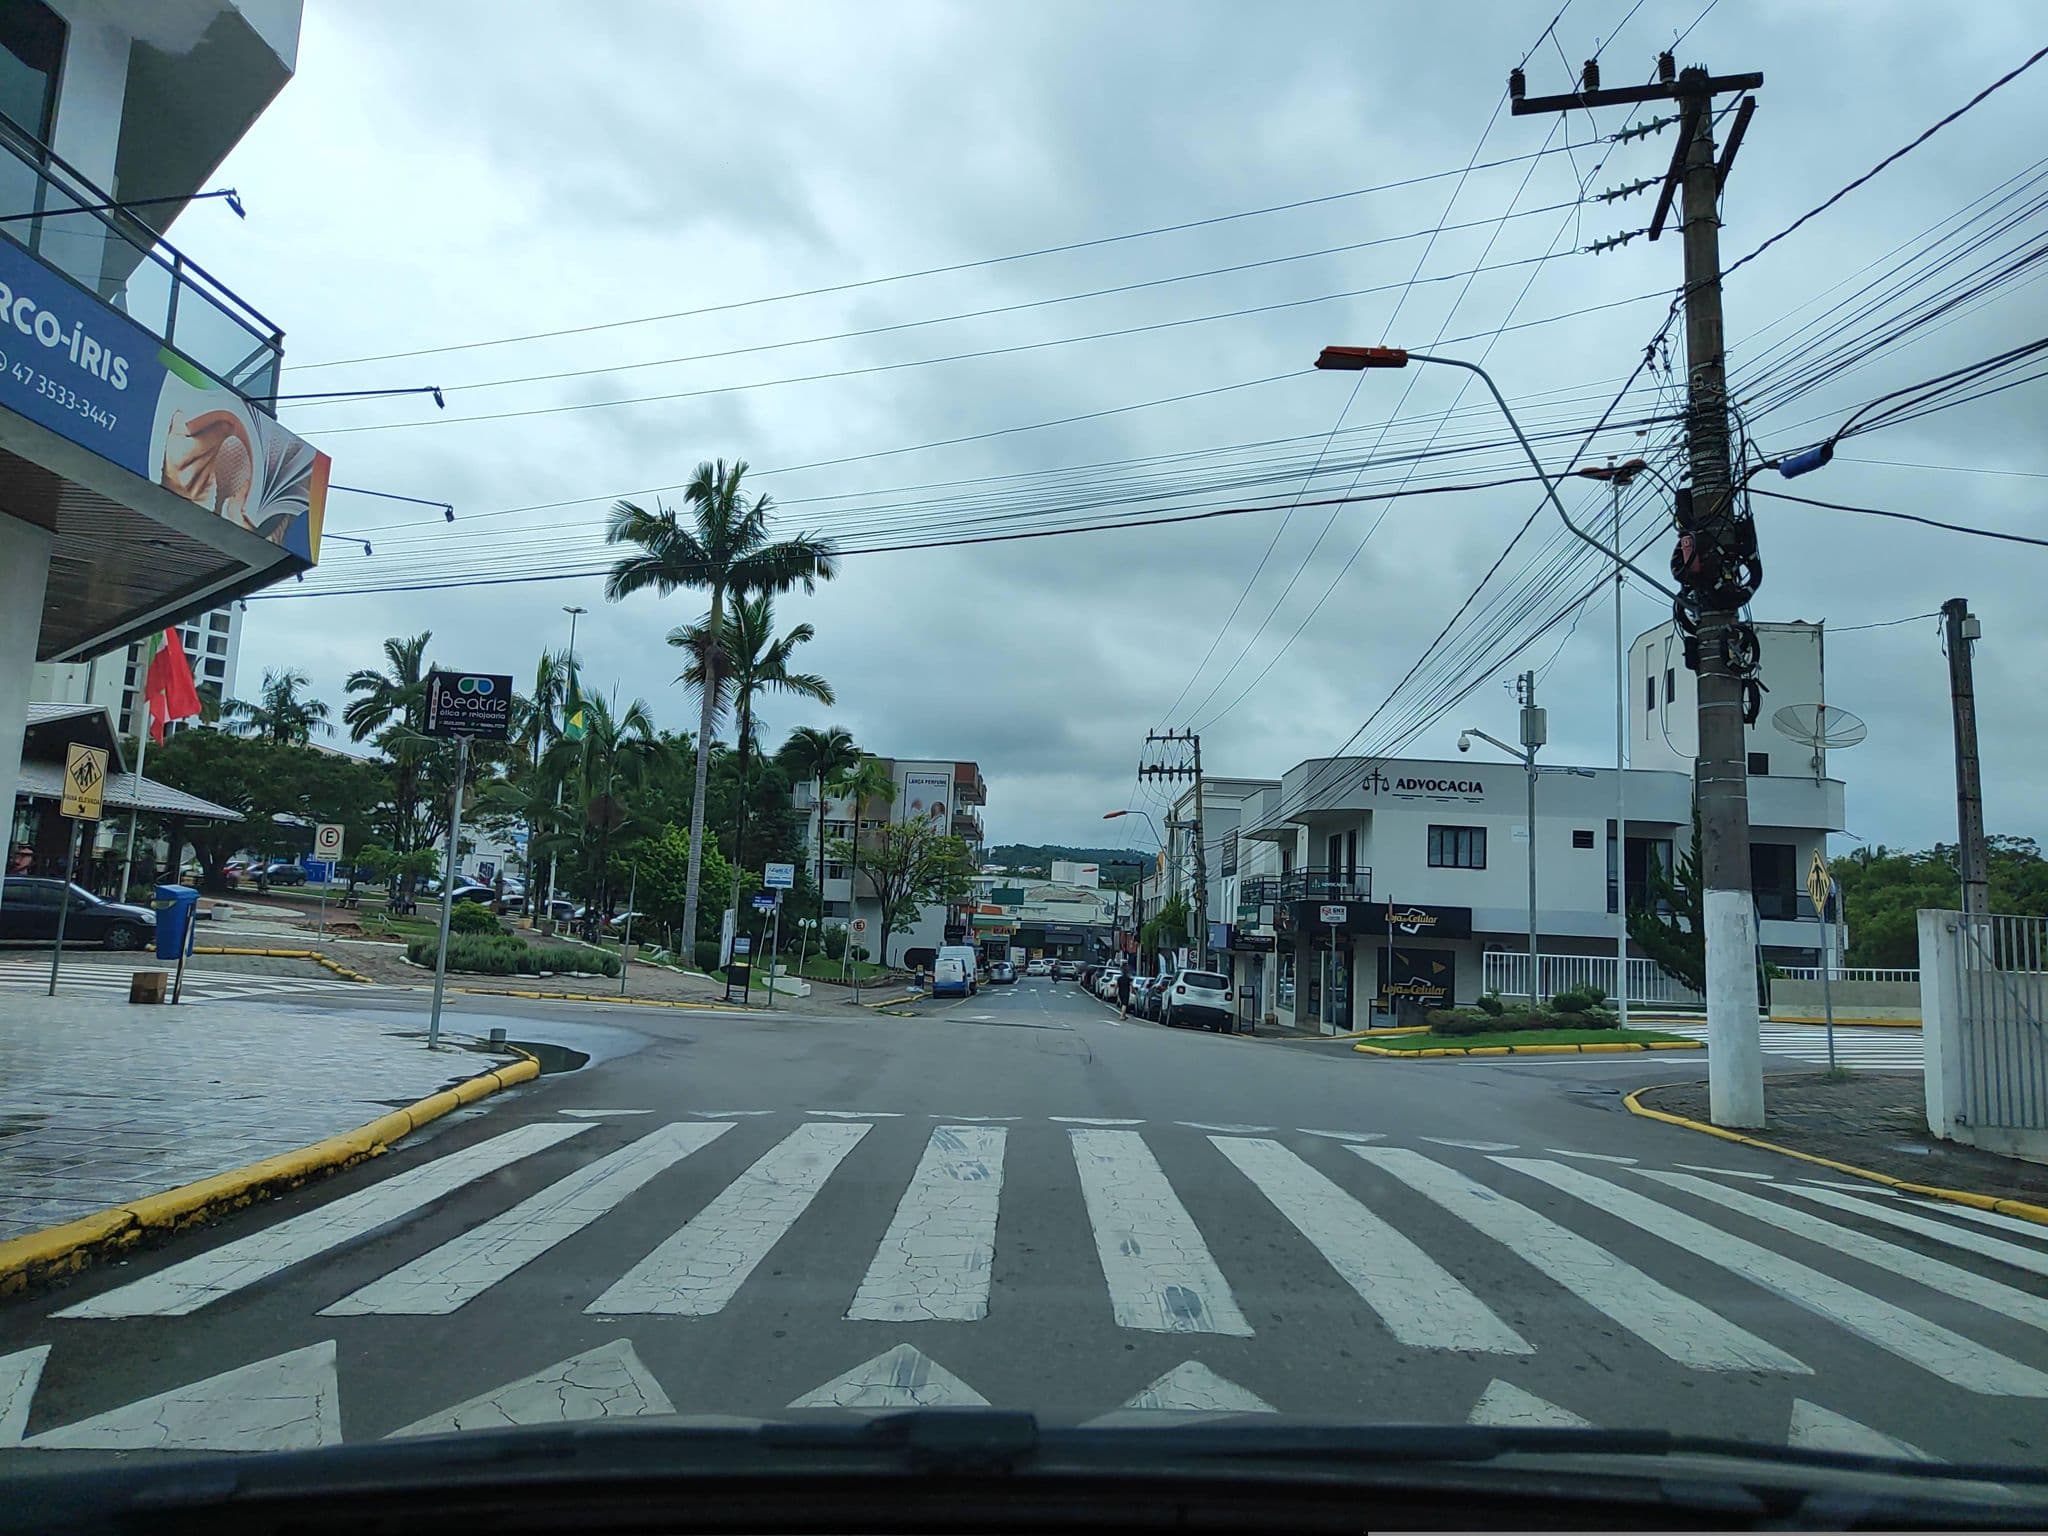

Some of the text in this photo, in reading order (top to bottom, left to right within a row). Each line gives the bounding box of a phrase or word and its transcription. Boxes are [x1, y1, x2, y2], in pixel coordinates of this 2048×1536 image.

[12, 362, 117, 432] 47 3533-3447
[441, 690, 507, 711] Beatriz
[1396, 778, 1483, 793] ADVOCACIA
[326, 831, 335, 843] E
[1408, 914, 1438, 924] Celular
[1410, 985, 1447, 996] Celular
